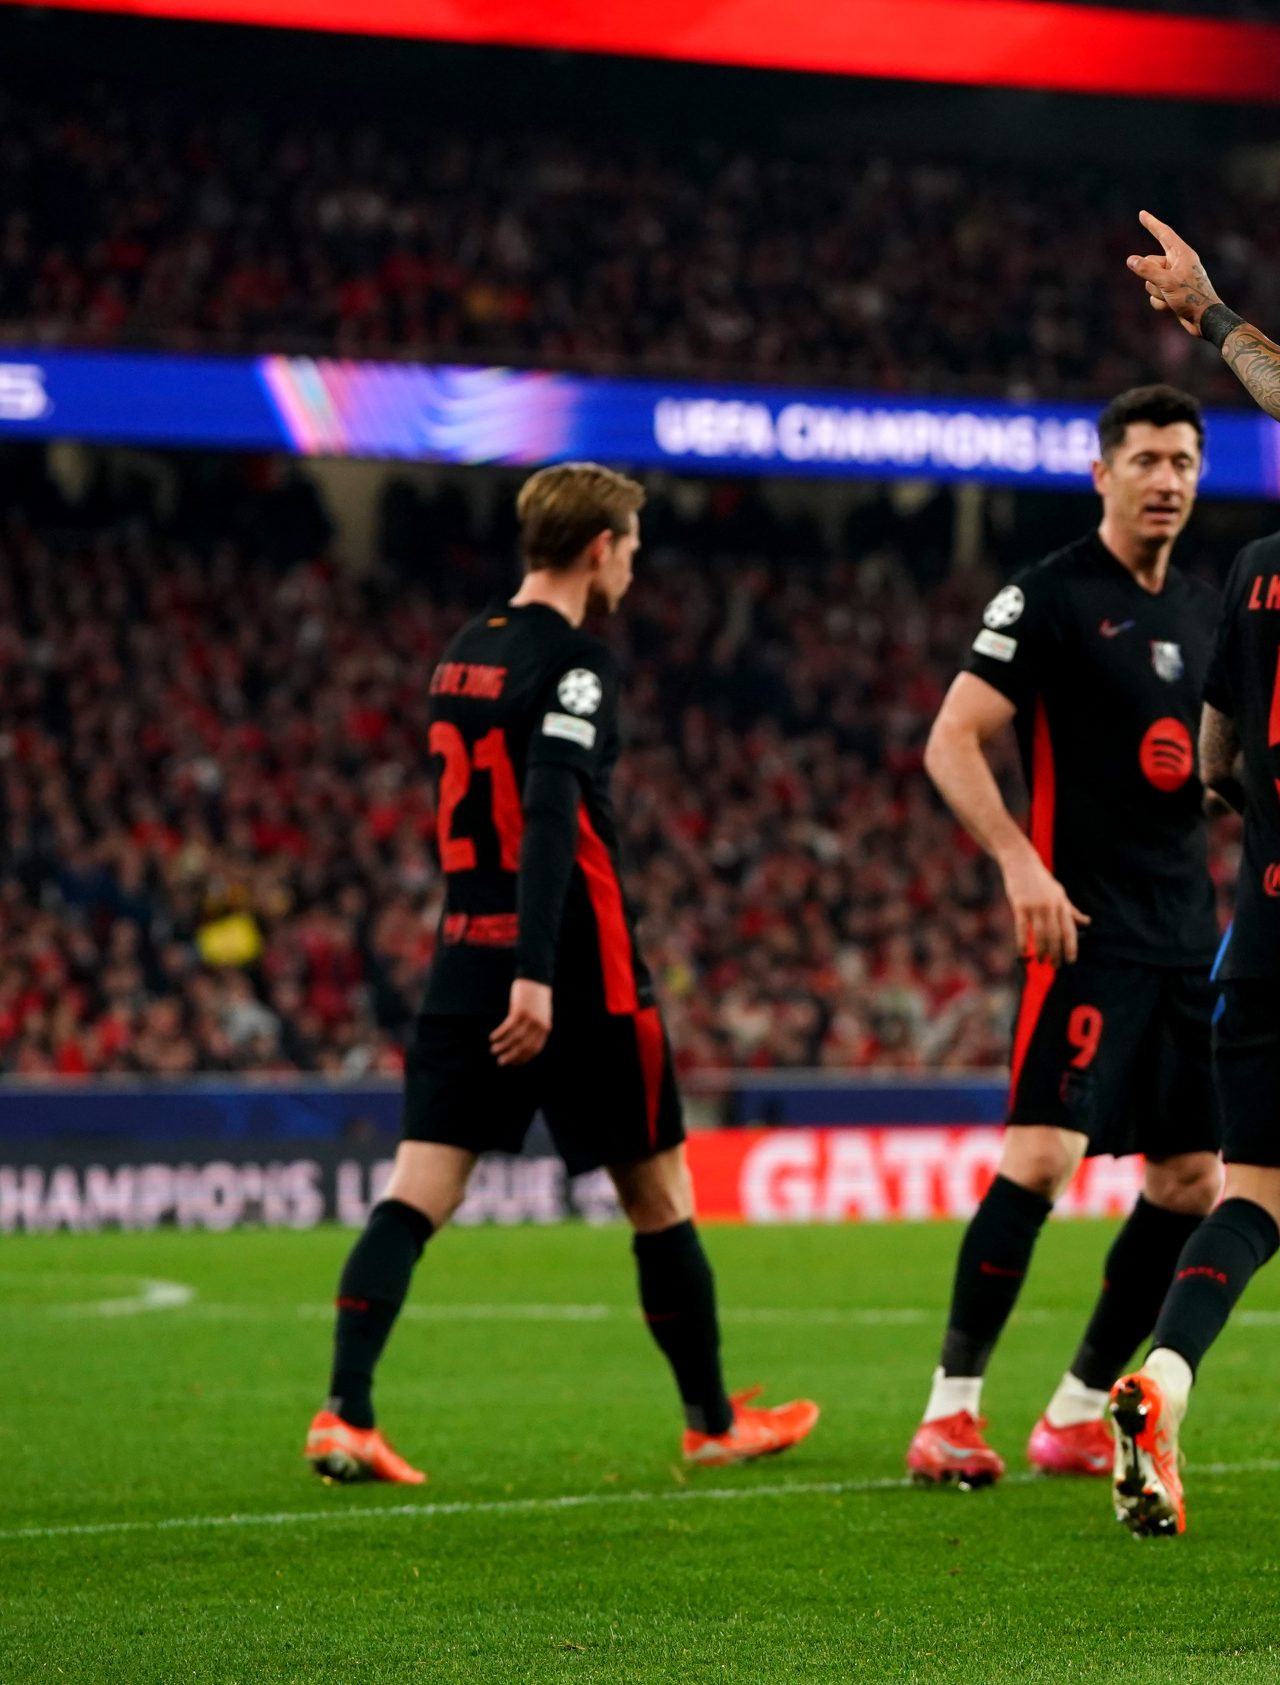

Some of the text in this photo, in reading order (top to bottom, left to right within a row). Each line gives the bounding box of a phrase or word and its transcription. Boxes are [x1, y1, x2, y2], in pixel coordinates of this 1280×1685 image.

[654, 398, 773, 459] UEFA
[776, 403, 1039, 474] CHAMPIONS
[428, 721, 525, 873] 21
[1067, 1004, 1103, 1070] 9
